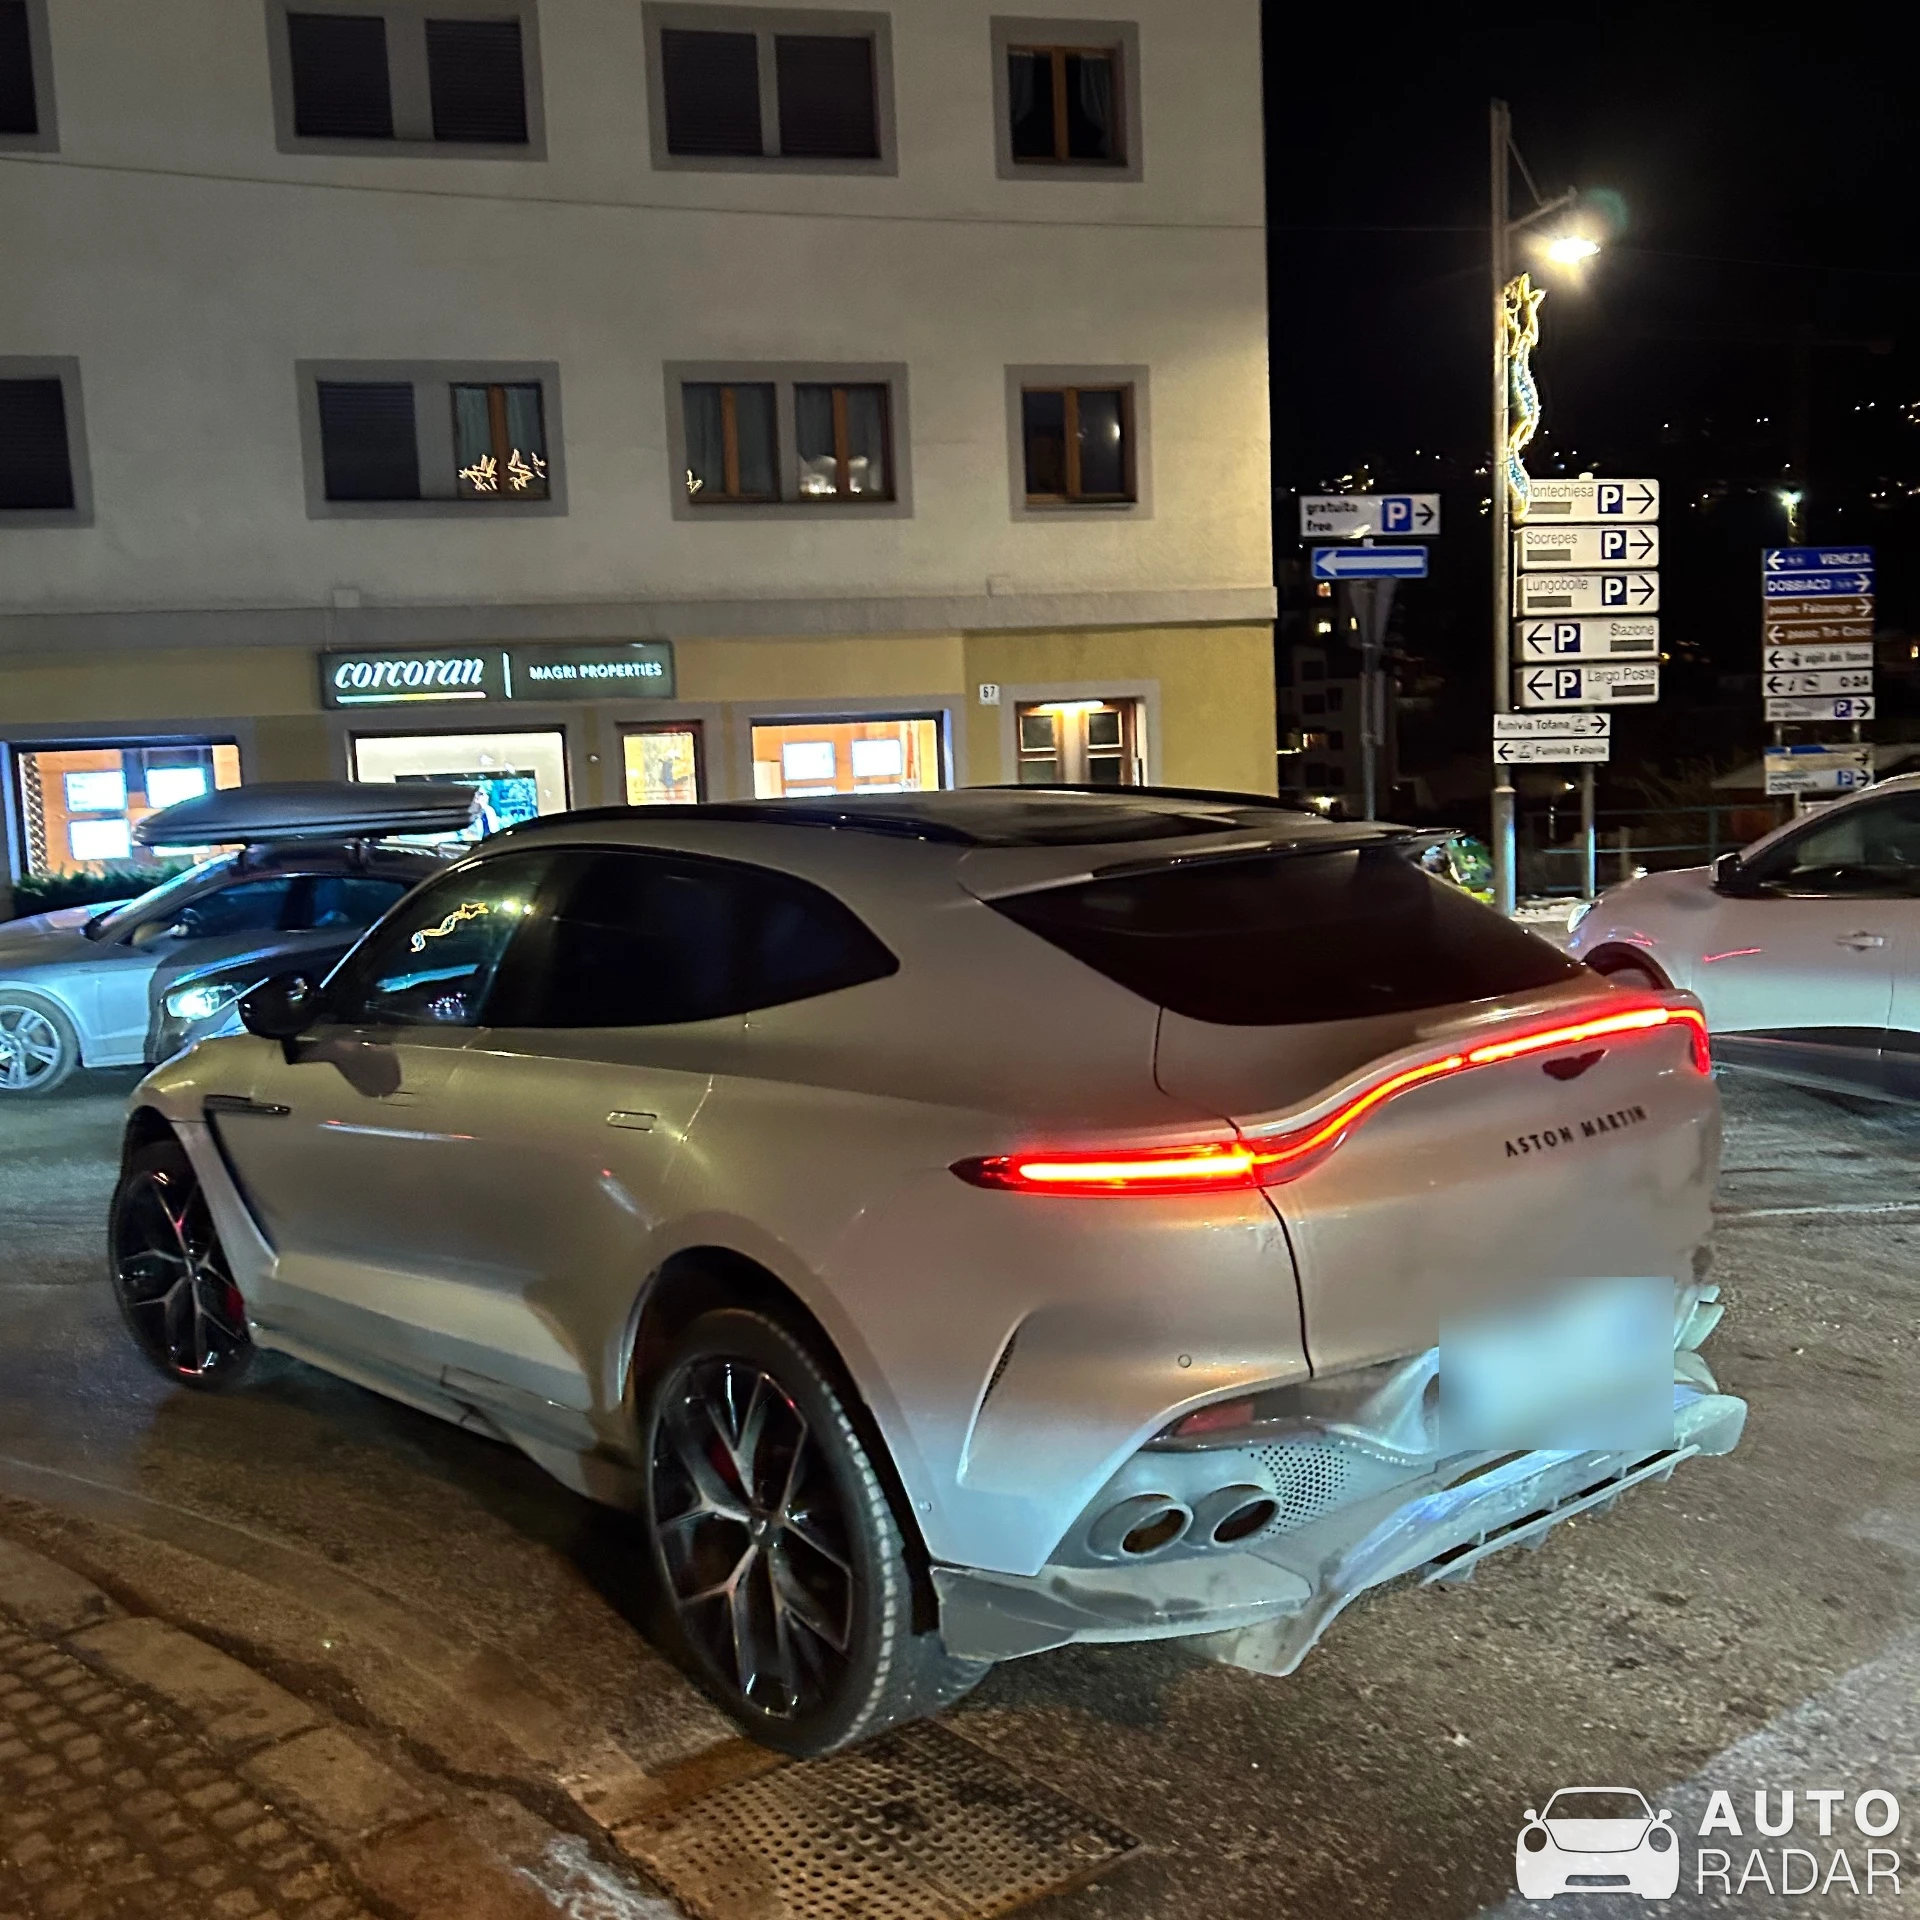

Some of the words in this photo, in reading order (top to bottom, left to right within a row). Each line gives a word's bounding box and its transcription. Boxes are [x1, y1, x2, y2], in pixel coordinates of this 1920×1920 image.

[1530, 481, 1594, 498] ontechiesa
[1601, 486, 1620, 512] P
[1387, 501, 1408, 529] P
[1526, 531, 1578, 547] Socrepes
[1604, 532, 1623, 558] P
[1605, 578, 1623, 604] P
[1558, 625, 1577, 651] P
[1610, 622, 1655, 637] Stazione
[334, 657, 484, 689] corcoran
[529, 664, 578, 681] MAGRI
[579, 661, 663, 680] PROPERTIES
[1559, 671, 1577, 697] P
[1587, 669, 1620, 684] Largo
[1623, 667, 1655, 682] Poste
[983, 685, 995, 698] 67
[1505, 1126, 1574, 1157] ASTON
[1580, 1105, 1647, 1137] MARTIN
